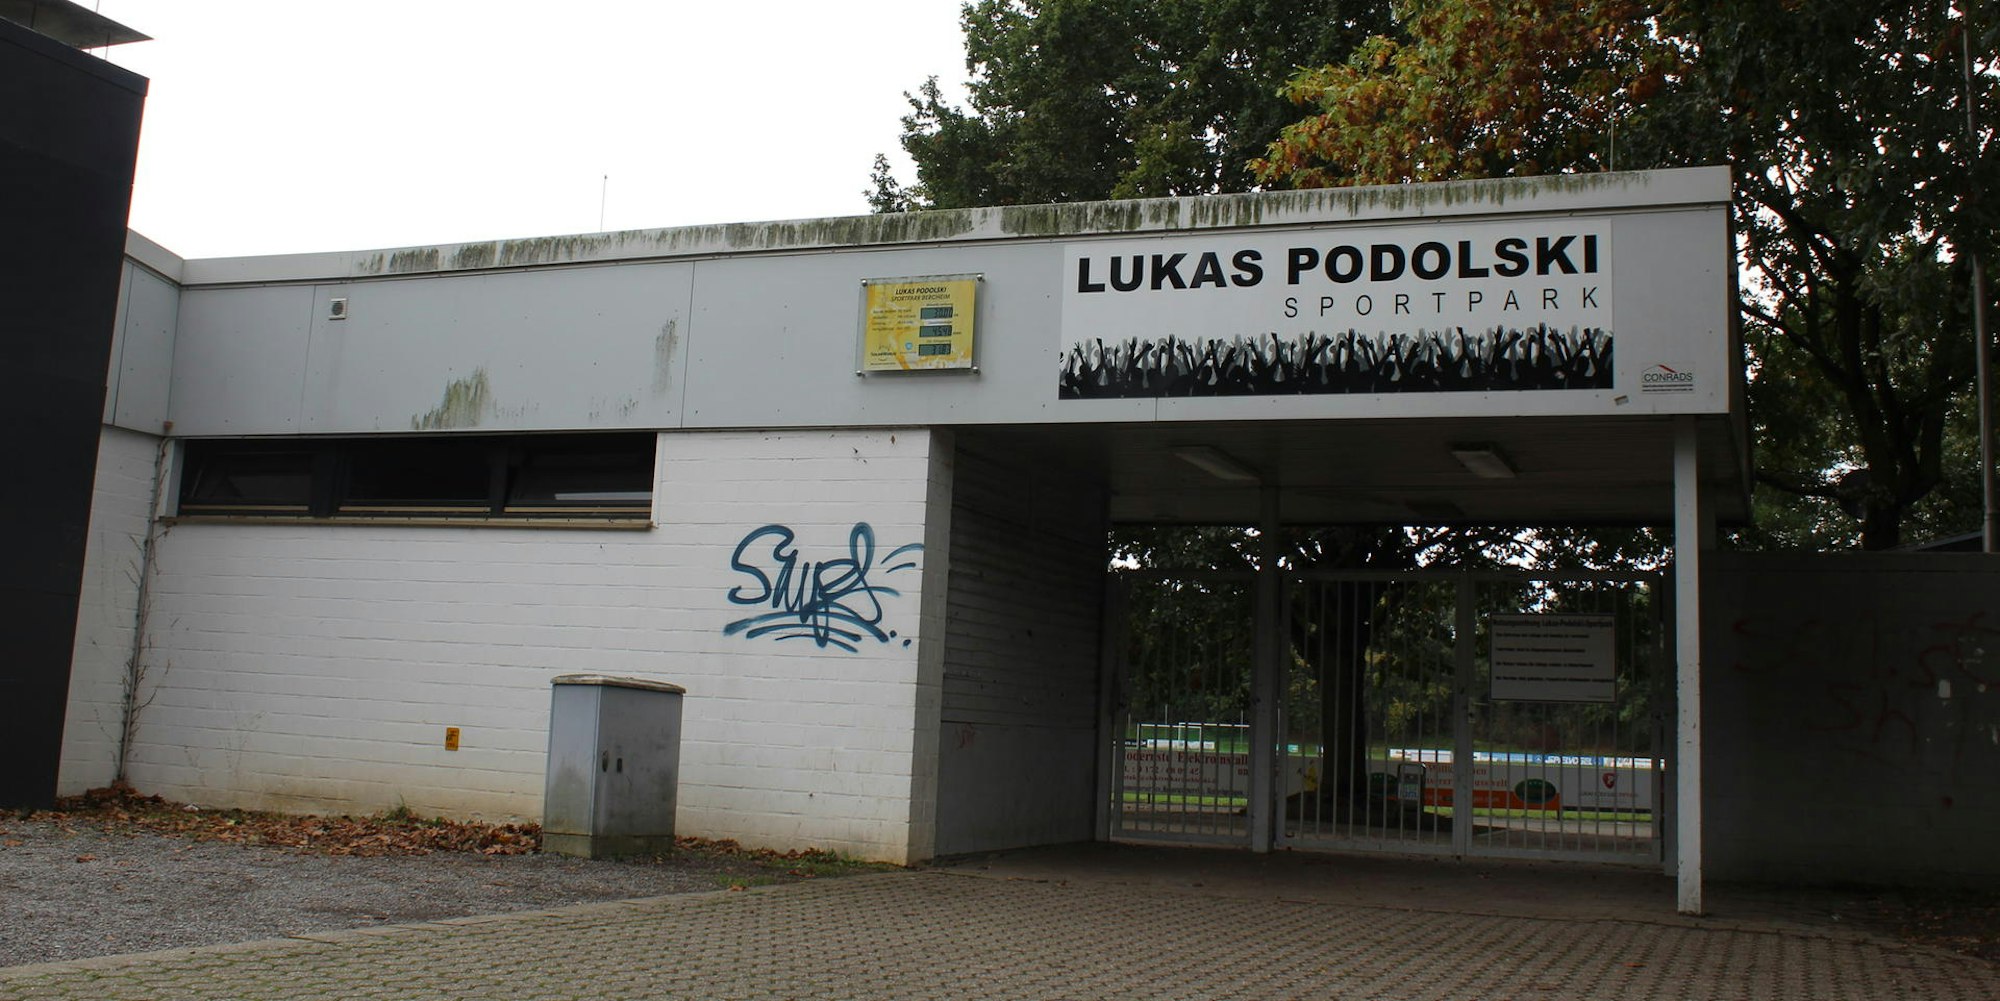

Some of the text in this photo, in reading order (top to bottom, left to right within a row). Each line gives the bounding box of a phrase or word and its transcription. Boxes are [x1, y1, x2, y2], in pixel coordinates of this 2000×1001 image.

[1078, 235, 1598, 293] LUKAS PODOLSKI
[1284, 286, 1598, 318] SPORTPARK
[1644, 372, 1693, 381] CONRADS
